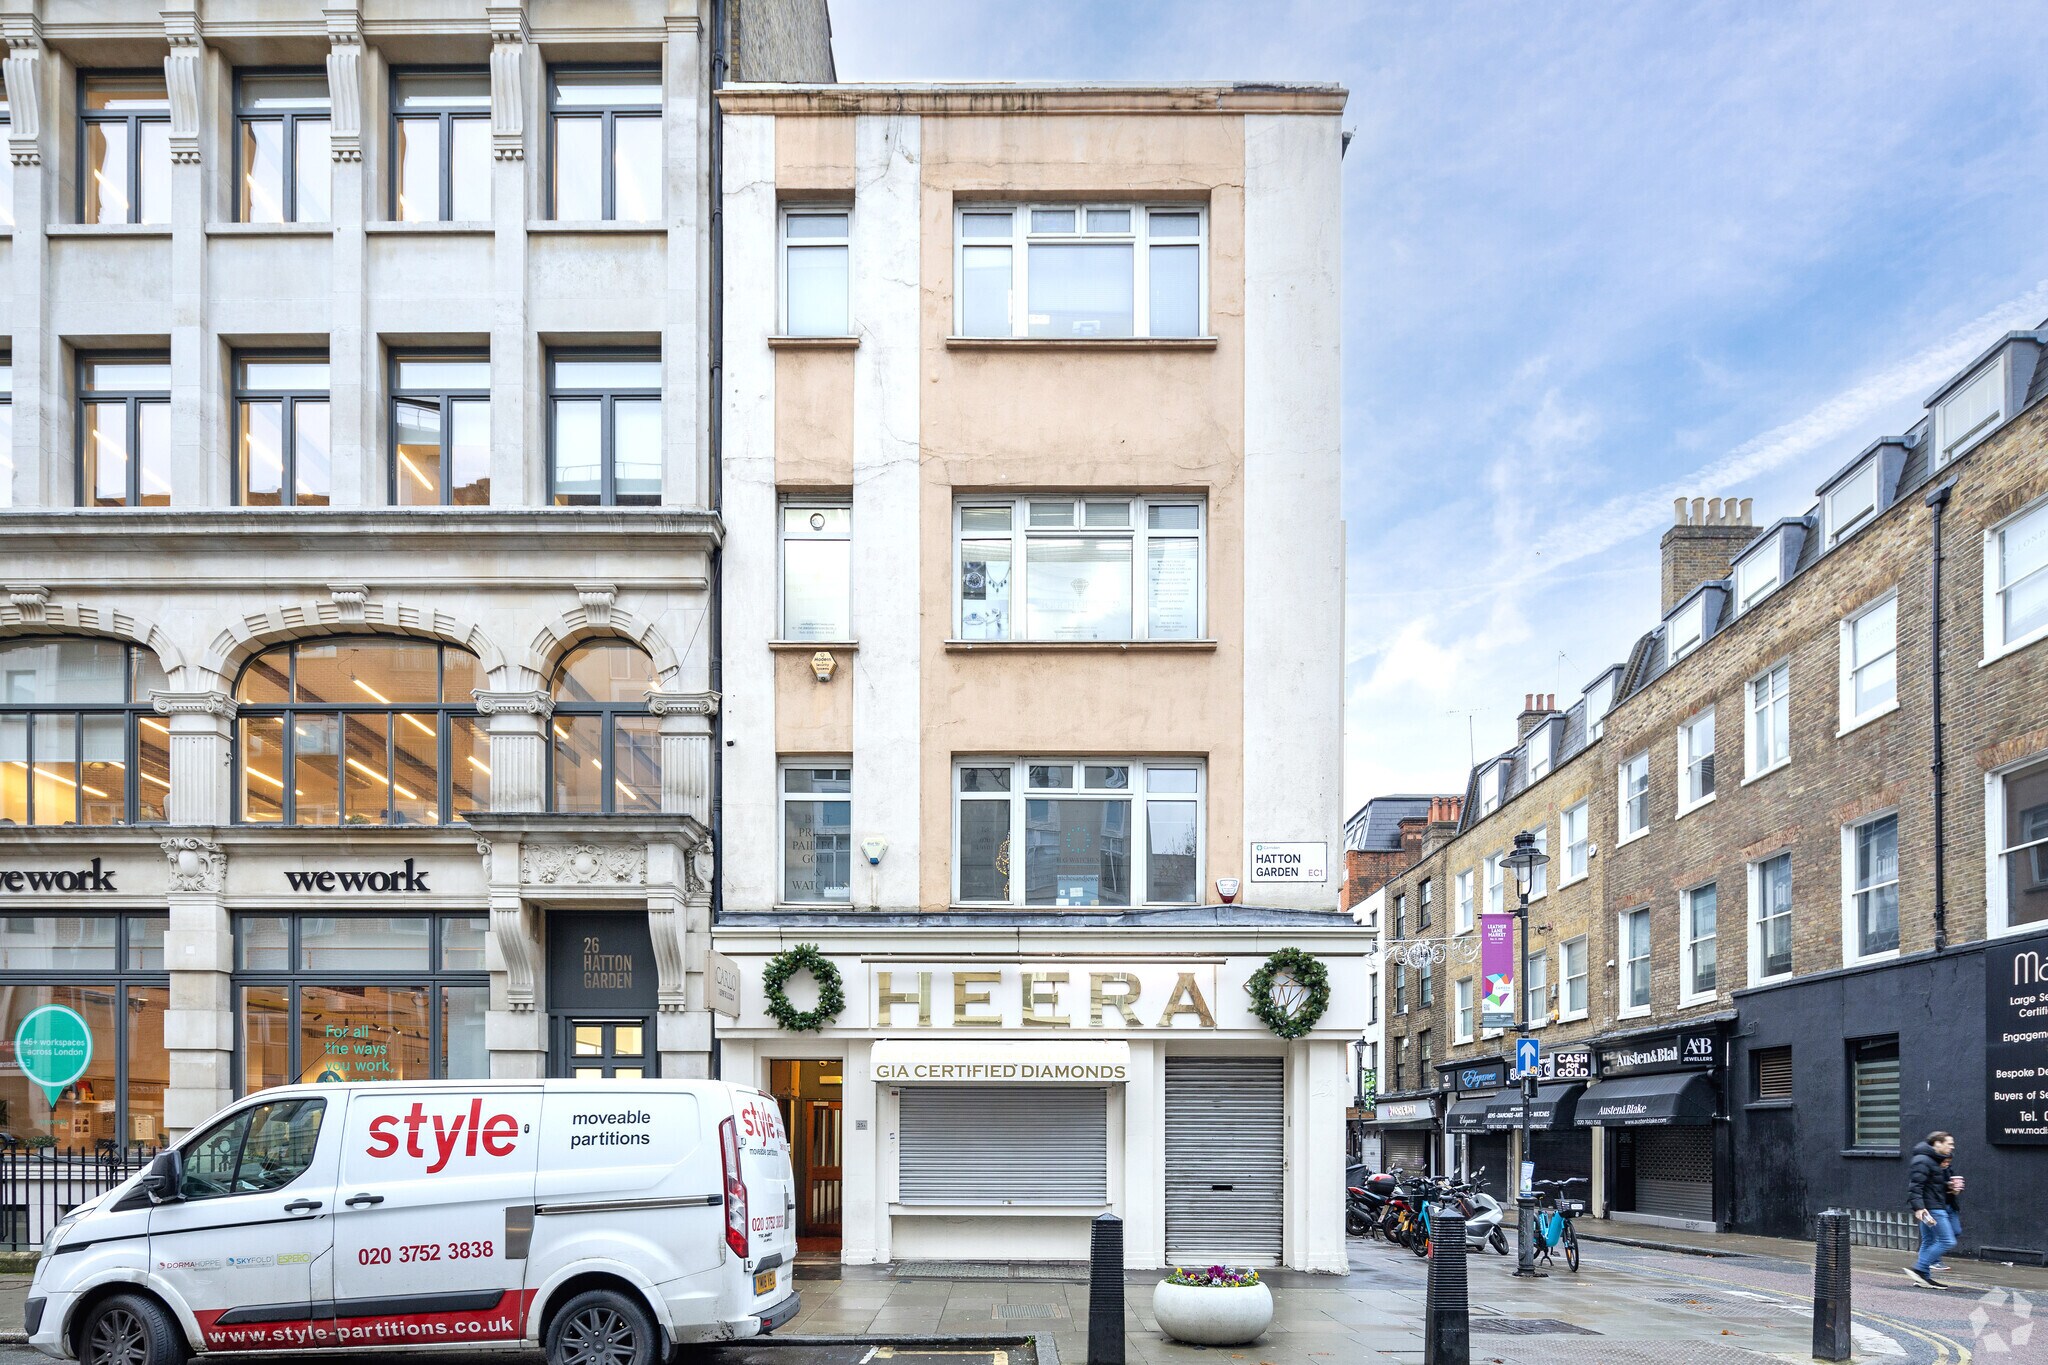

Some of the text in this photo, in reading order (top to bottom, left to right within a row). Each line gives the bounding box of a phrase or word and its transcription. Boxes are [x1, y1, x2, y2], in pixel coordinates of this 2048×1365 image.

[1256, 854, 1301, 864] HATTON
[284, 858, 430, 892] wework
[1256, 867, 1323, 877] GARDEN EC1
[584, 937, 600, 954] 26
[584, 955, 632, 971] HATTON
[584, 972, 632, 989] GARDEN
[876, 970, 1217, 1028] HEERA
[2010, 995, 2036, 1006] Large
[325, 1024, 369, 1038] For all
[40, 1038, 86, 1048] workspaces
[325, 1042, 387, 1058] the ways
[1684, 1037, 1712, 1055] A&B
[54, 1048, 84, 1056] London
[1557, 1053, 1588, 1064] CASH
[326, 1059, 395, 1075] you work,
[876, 1064, 1126, 1079] GIA CERTIFIED DIAMONDS
[1557, 1067, 1589, 1077] GOLD
[1996, 1068, 2035, 1079] Bespoke
[1462, 1069, 1497, 1089] Elegance
[1994, 1092, 2024, 1102] Buyers
[2026, 1091, 2037, 1100] of
[1597, 1104, 1647, 1116] Austen&Blake
[2020, 1110, 2038, 1122] Tel.
[572, 1110, 651, 1125] moveable
[742, 1102, 776, 1147] style
[1624, 1117, 1667, 1125] www.austenblake.com
[366, 1098, 519, 1174] style
[570, 1131, 651, 1149] partitions
[752, 1217, 764, 1231] 020
[278, 1253, 310, 1264] ESPERO
[358, 1240, 494, 1266] 020 3752 3838
[236, 1256, 272, 1265] SKYFOLD
[208, 1316, 514, 1344] www.style-partitions.co.uk
